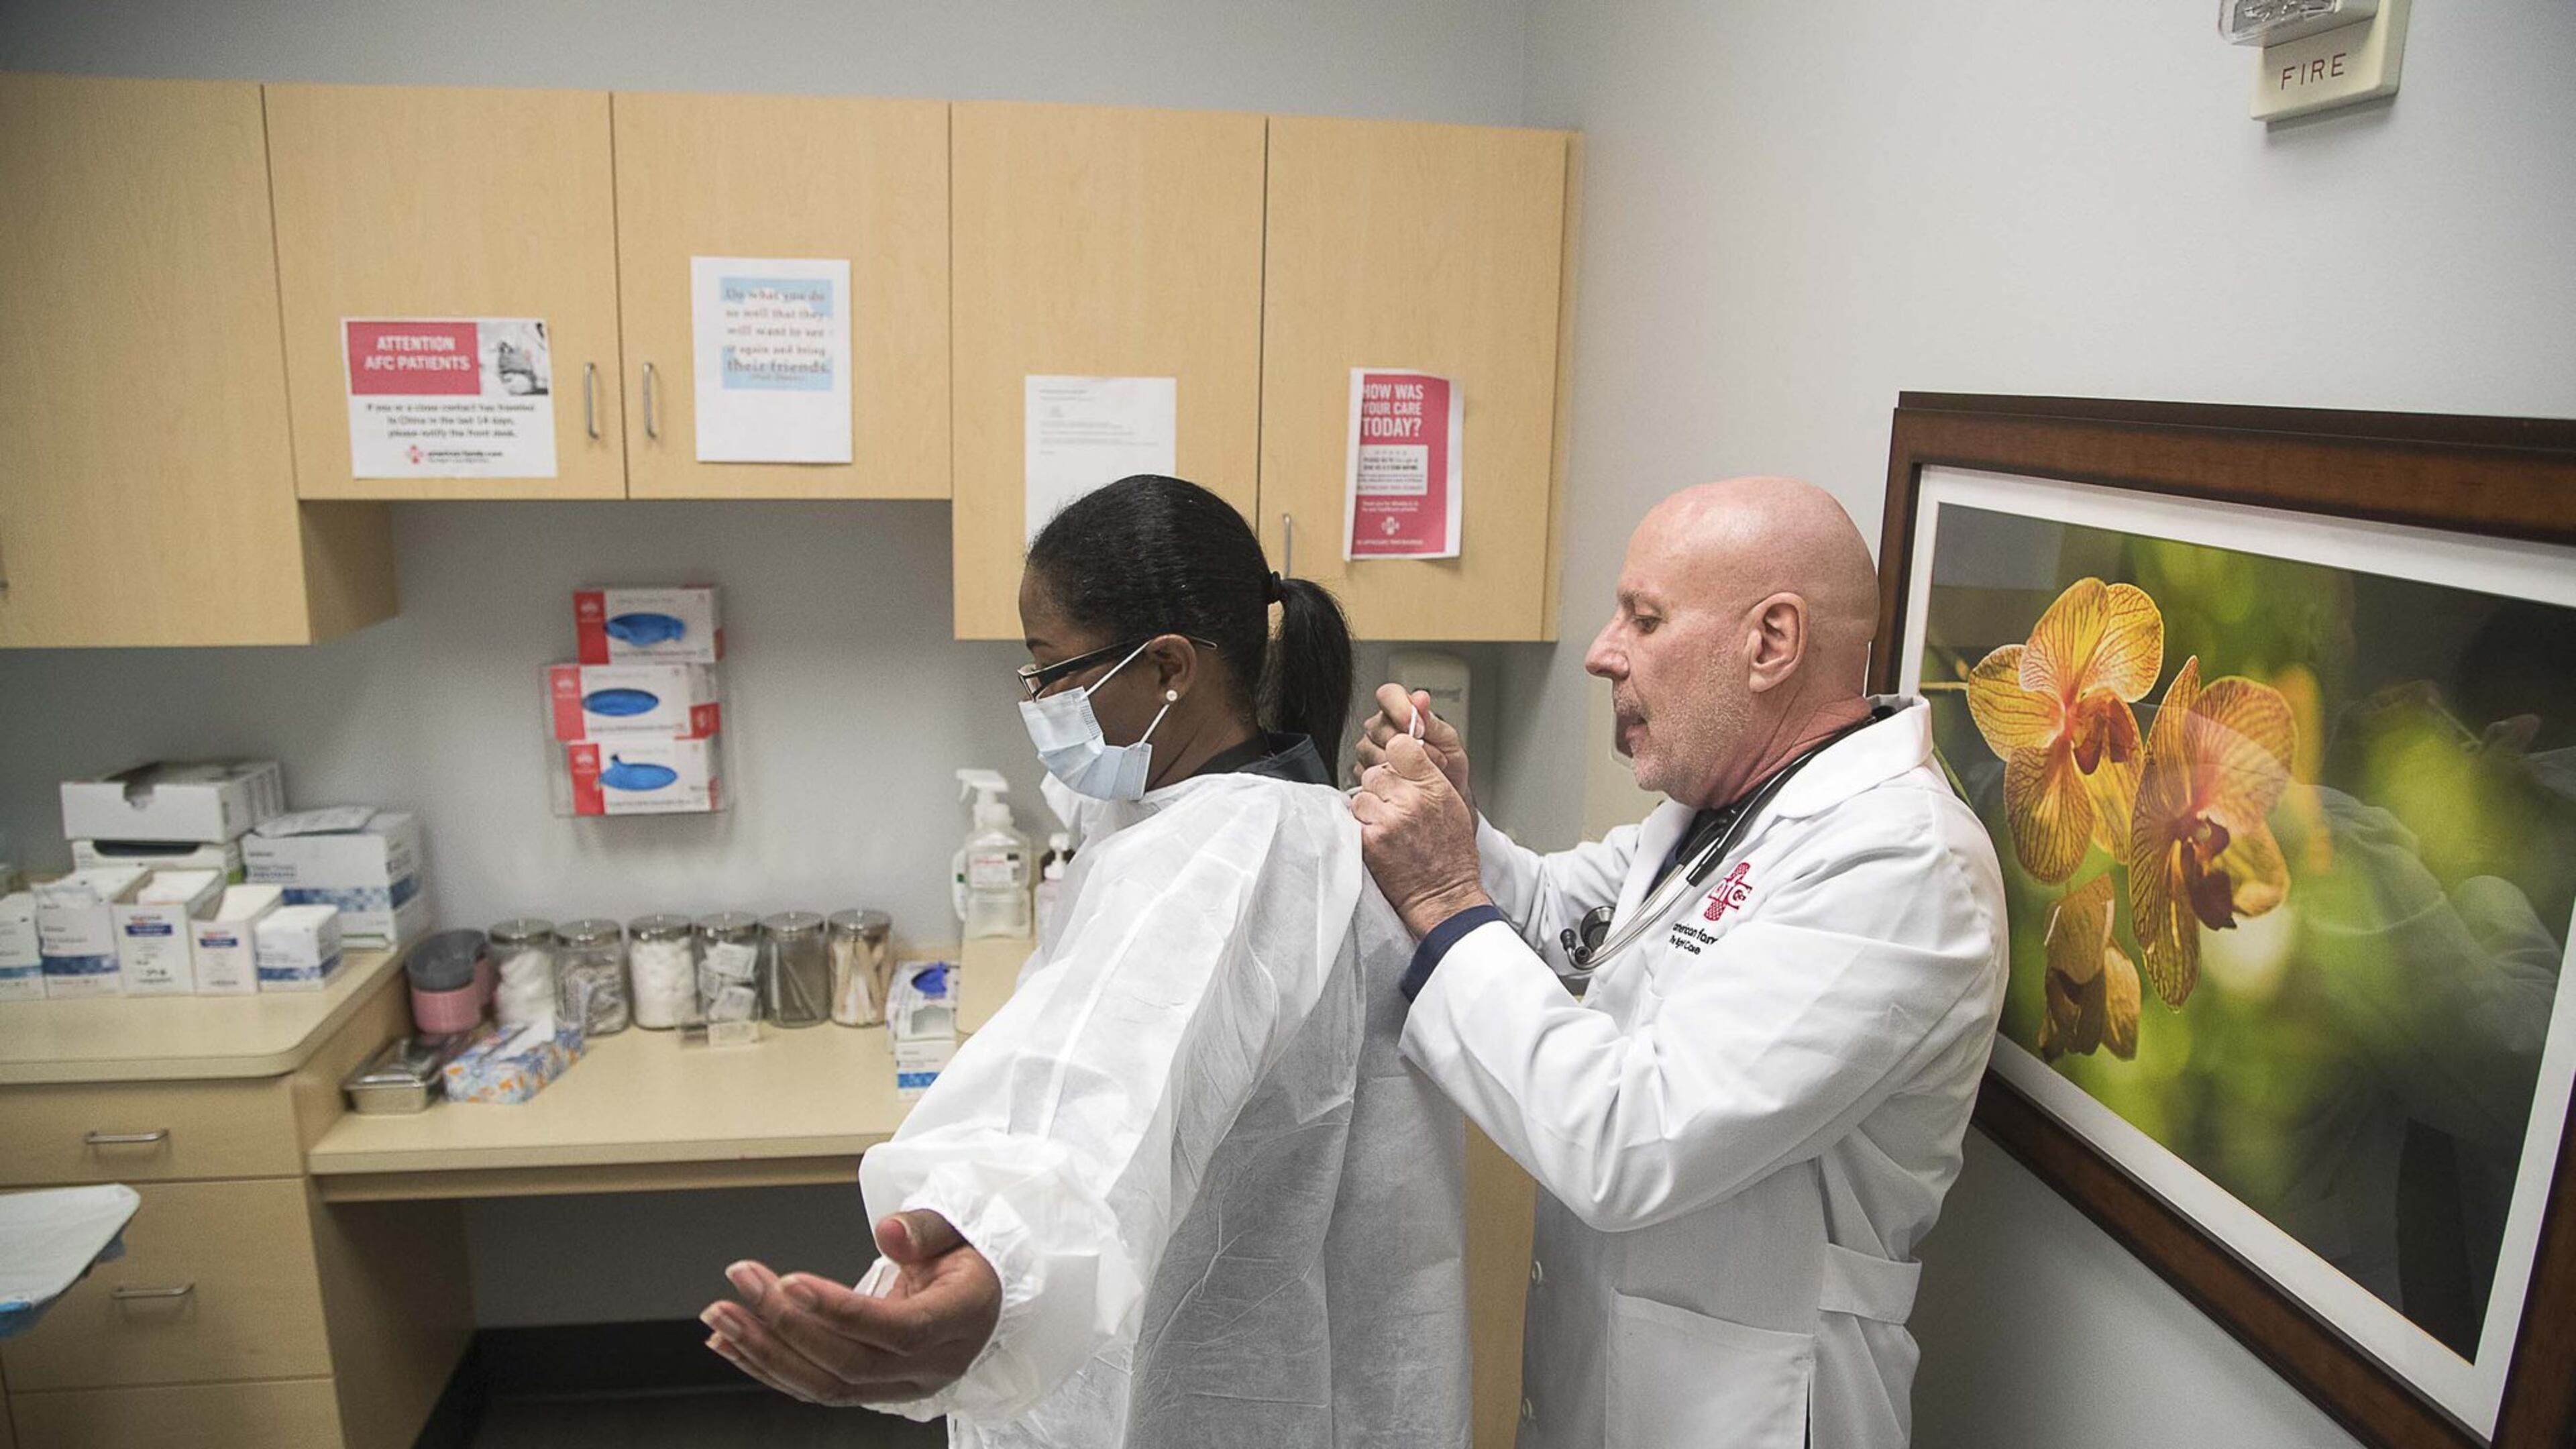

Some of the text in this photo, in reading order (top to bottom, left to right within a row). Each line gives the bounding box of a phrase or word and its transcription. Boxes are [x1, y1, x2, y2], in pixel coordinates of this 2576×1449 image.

[2281, 53, 2347, 90] FIRE
[376, 336, 455, 351] ATTENTION
[364, 356, 471, 370] AFC PATIENTS
[1363, 384, 1424, 400] HOW WAS
[1363, 402, 1422, 416] YOUR CARE
[1363, 417, 1421, 437] TODAY?
